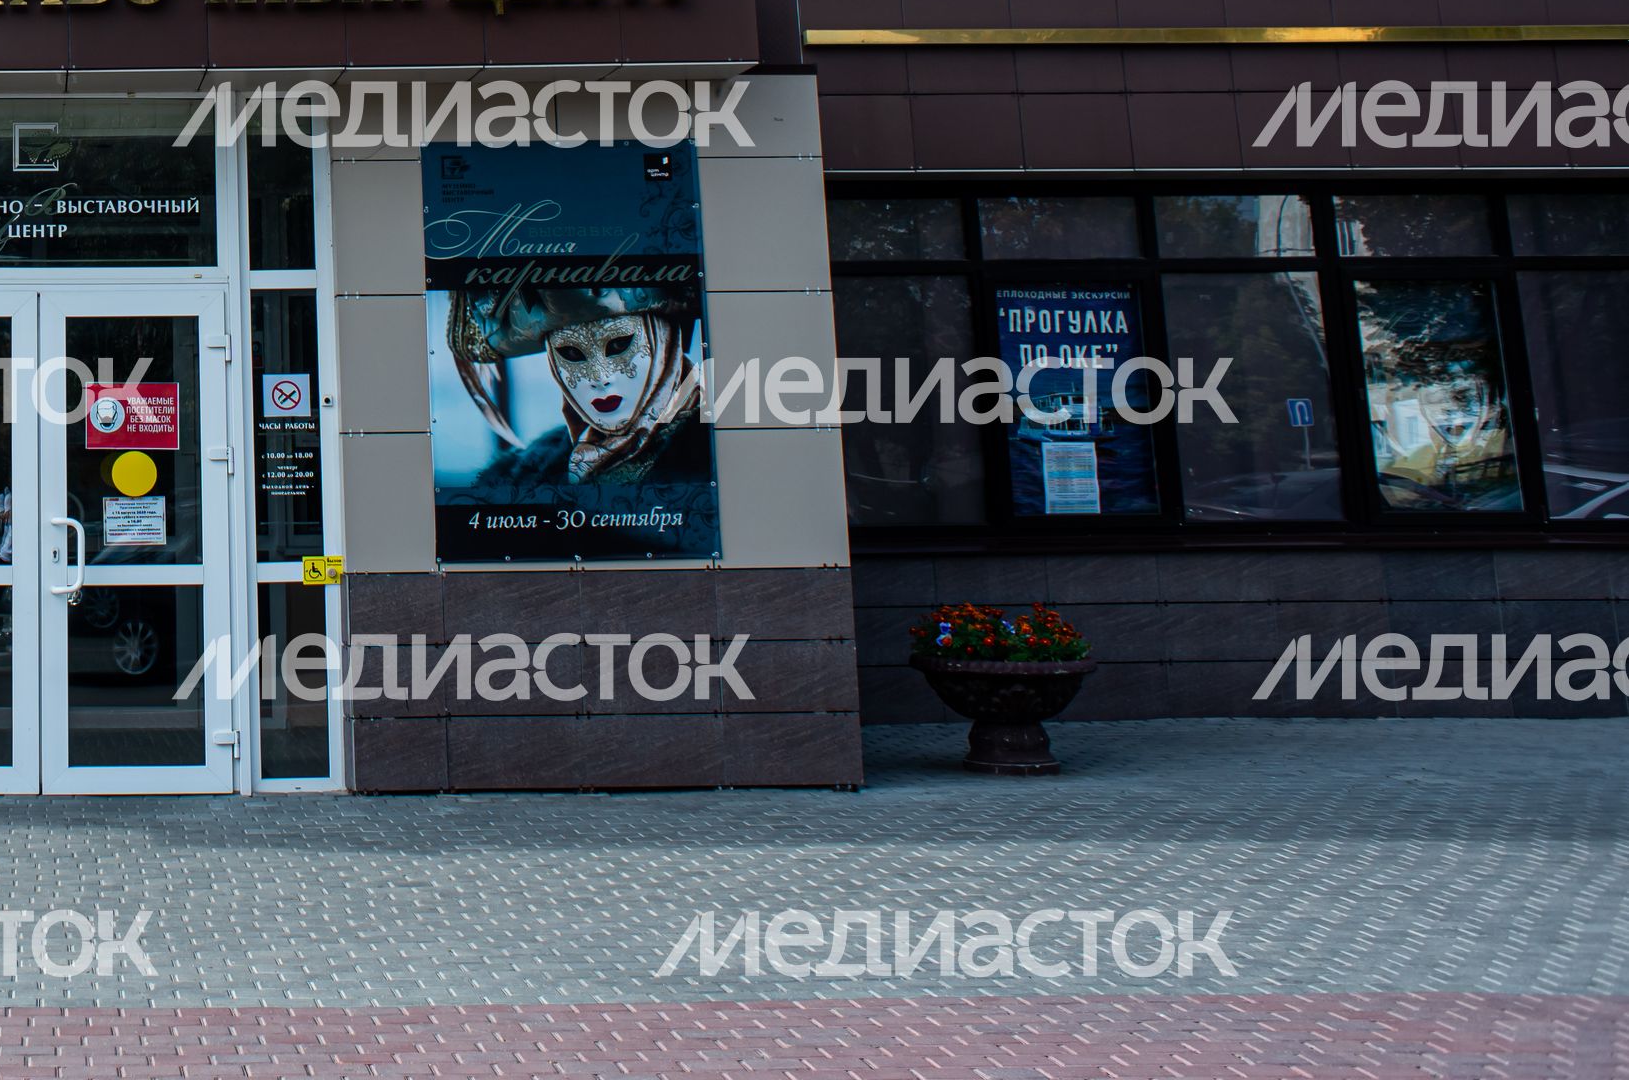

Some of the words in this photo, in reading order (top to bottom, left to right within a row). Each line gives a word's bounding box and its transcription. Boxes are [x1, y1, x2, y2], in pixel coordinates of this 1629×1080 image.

[56, 195, 200, 214] ВЫСТАВОЧНЫЙ
[8, 223, 68, 239] ЦЕНТР
[424, 199, 578, 260] Магия
[528, 223, 625, 238] выставка
[464, 233, 692, 314] карнавала
[1071, 290, 1131, 300] ЭКСКУРСИИ
[1019, 344, 1048, 368] ПО
[127, 396, 174, 405] УВАЖАЕМЫЕ
[126, 406, 175, 414] ПОСЕТИТЕЛИ!
[130, 415, 143, 423] БЕЗ
[145, 415, 171, 423] МАСОК
[259, 422, 281, 430] ЧАСЫ
[285, 422, 315, 430] РАБОТЫ
[127, 424, 137, 432] НЕ
[139, 424, 174, 433] ВХОДИТЬ!
[469, 512, 480, 529] 4
[486, 515, 538, 529] июля
[591, 506, 684, 532] сентября
